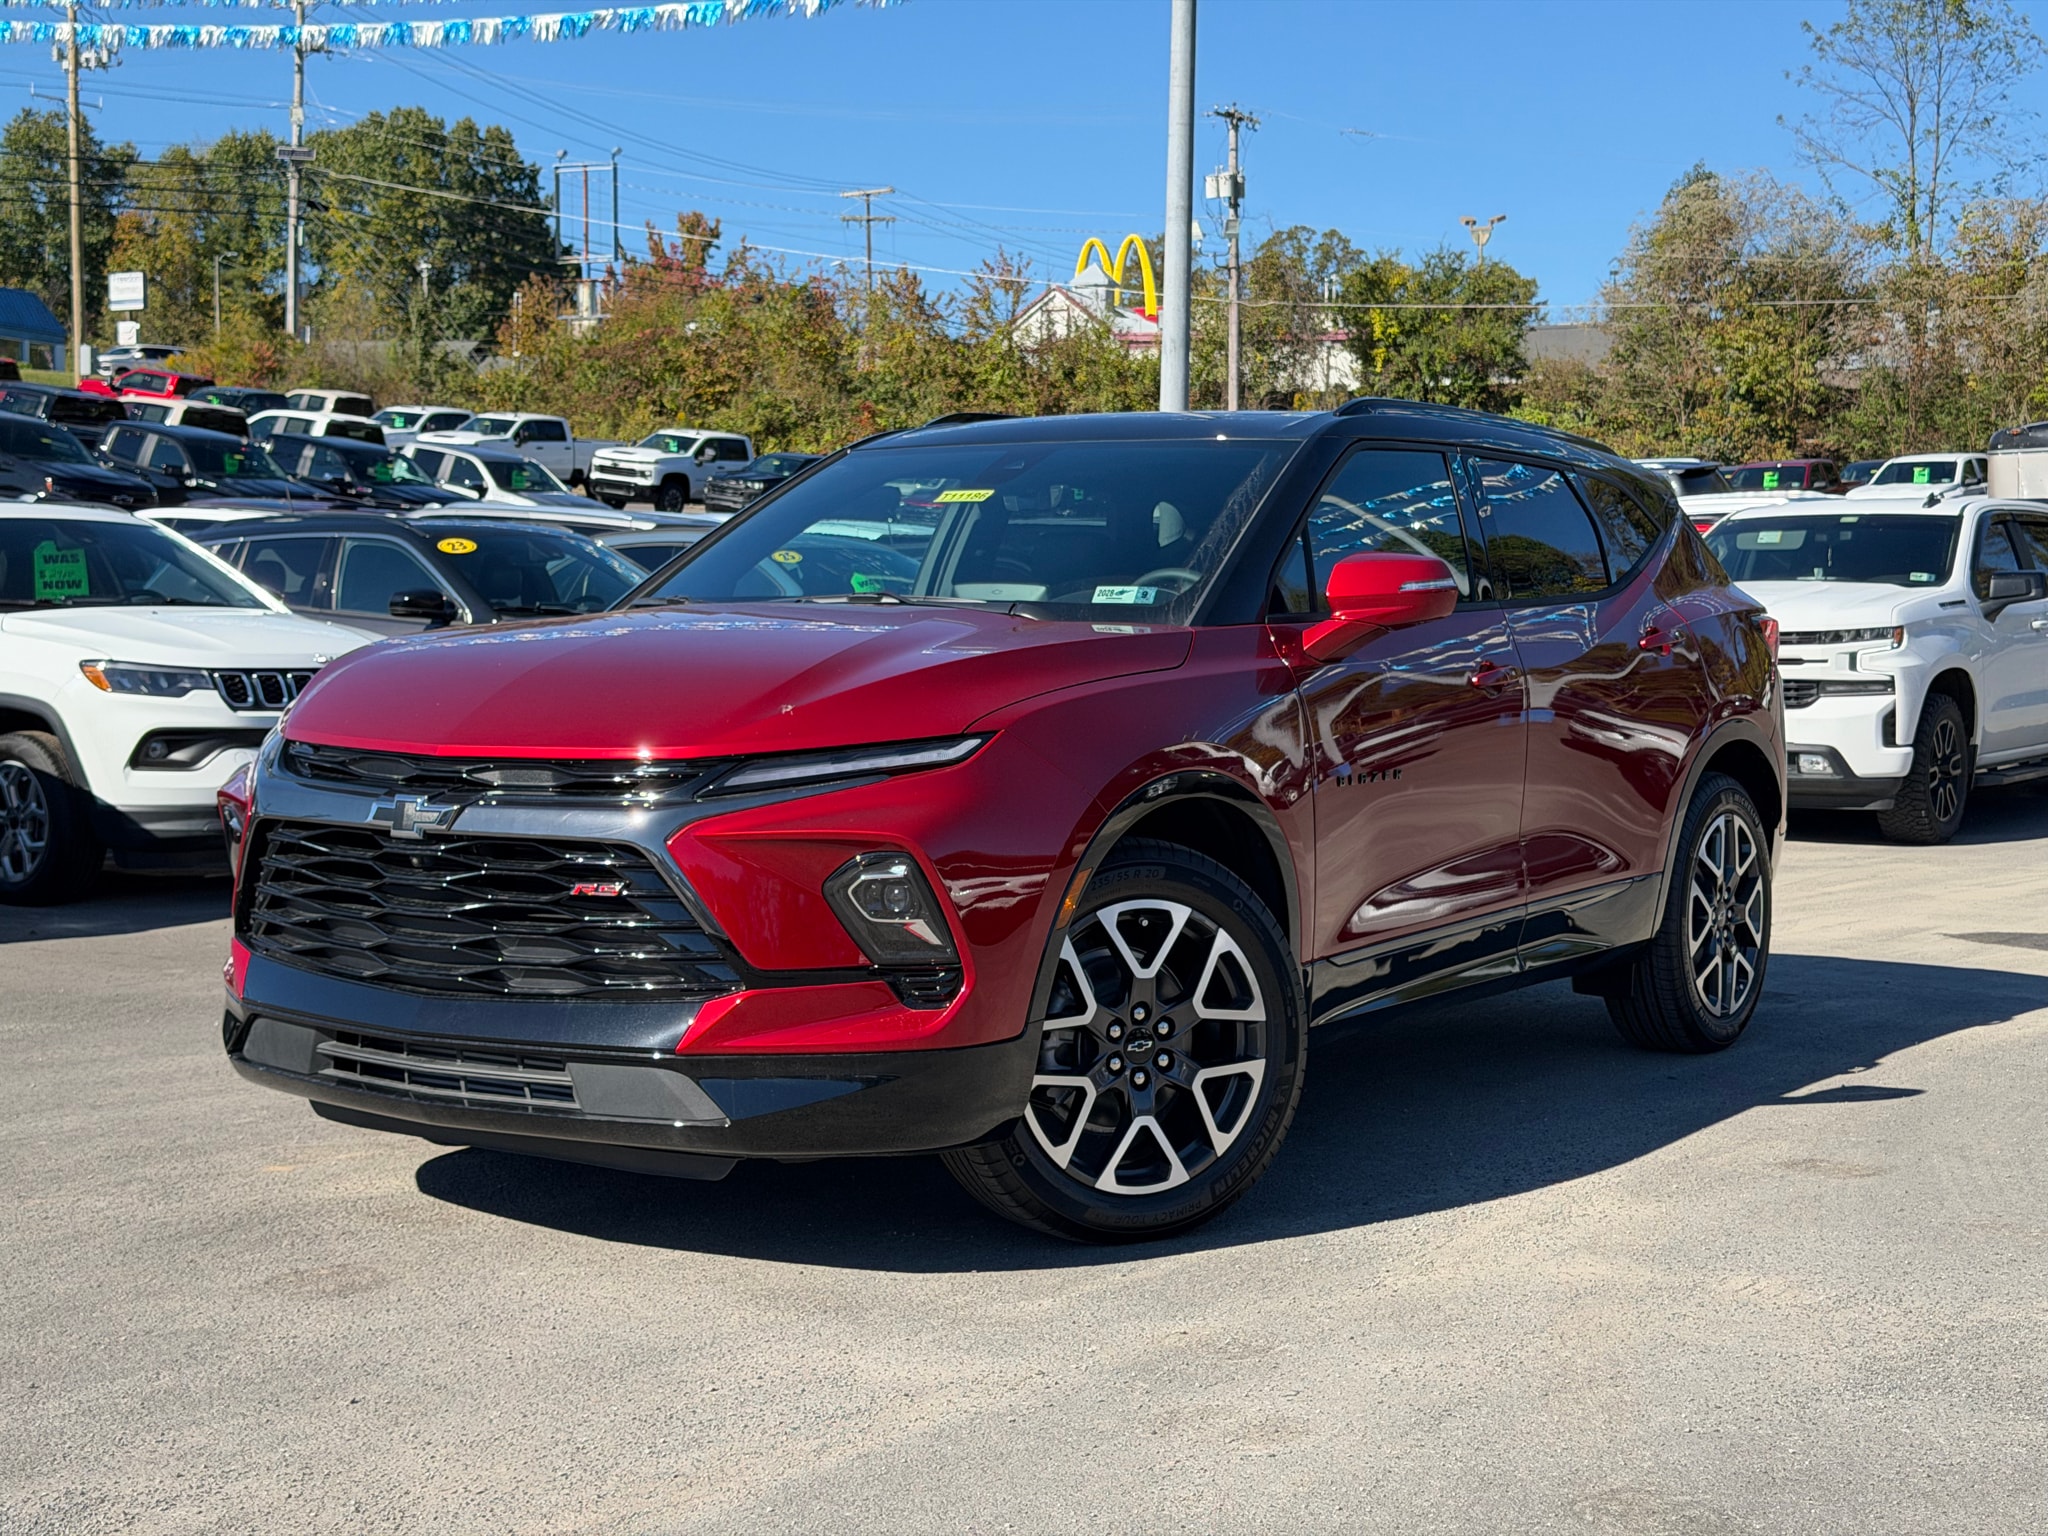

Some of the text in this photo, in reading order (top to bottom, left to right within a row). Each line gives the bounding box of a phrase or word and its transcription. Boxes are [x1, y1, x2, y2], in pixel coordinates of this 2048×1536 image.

[446, 541, 468, 551] 23
[42, 553, 80, 564] WAS
[43, 580, 82, 590] NOW
[1141, 590, 1149, 599] 9
[1145, 868, 1160, 879] 20
[1213, 1106, 1281, 1197] MICHELIN
